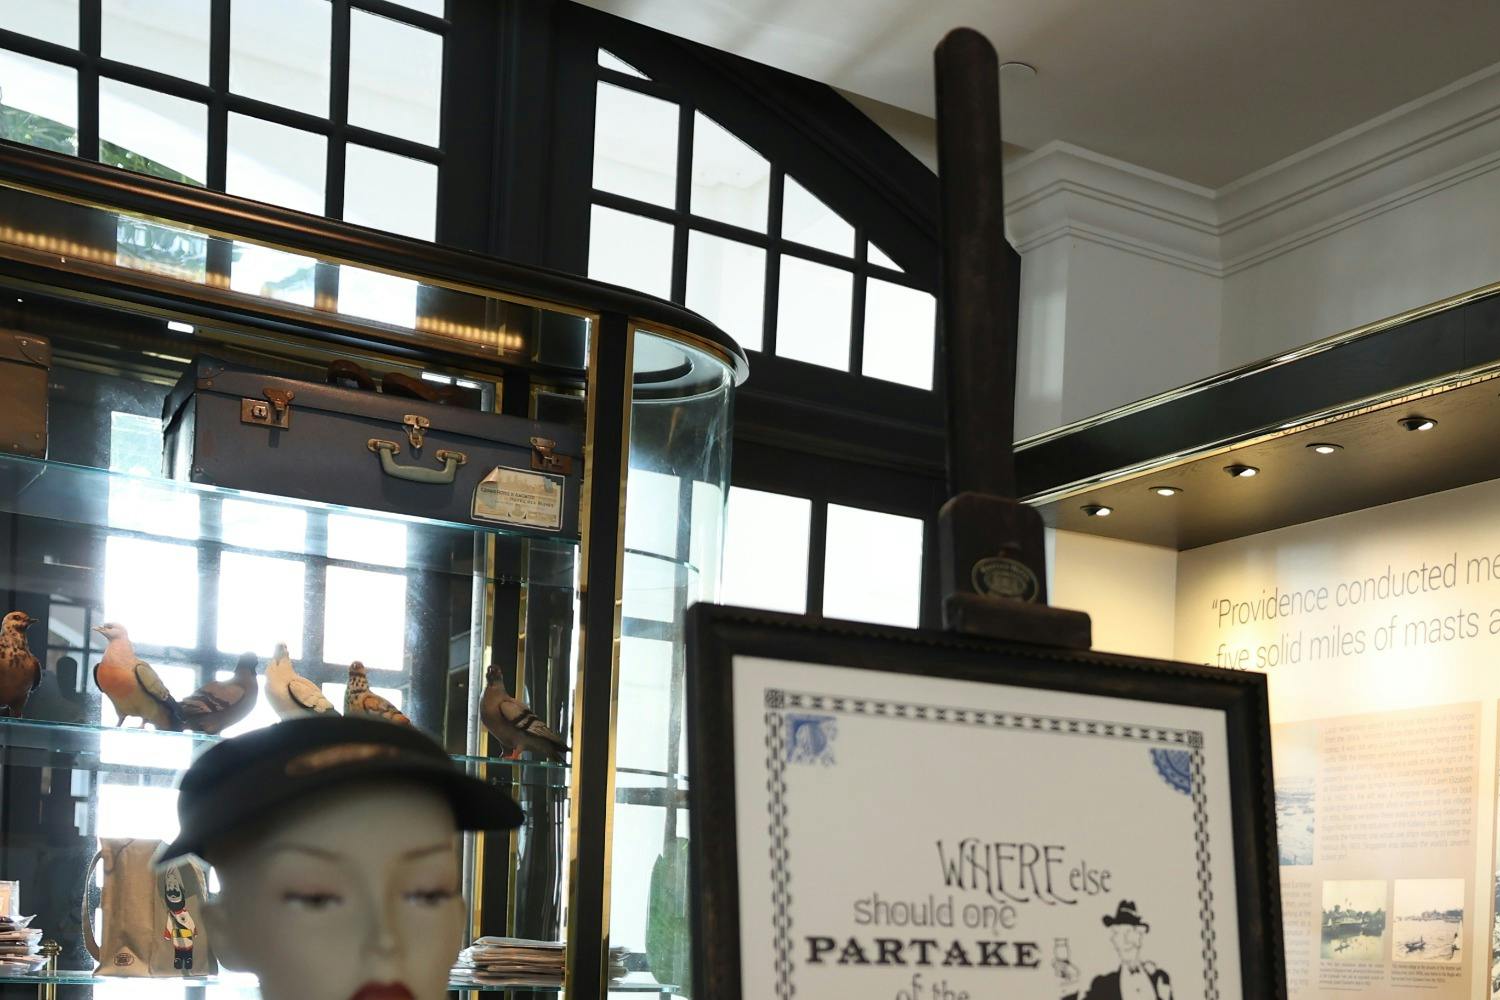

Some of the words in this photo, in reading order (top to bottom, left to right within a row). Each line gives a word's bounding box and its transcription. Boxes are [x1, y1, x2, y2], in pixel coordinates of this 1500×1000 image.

[1212, 587, 1329, 628] “Providence
[1336, 552, 1457, 608] conducted
[1216, 643, 1249, 671] five
[1256, 634, 1301, 670] solid
[1309, 625, 1366, 661] miles
[1374, 615, 1399, 651] of
[1404, 608, 1479, 647] masts
[937, 839, 1077, 906] WHERE
[1069, 863, 1112, 896] else
[854, 892, 955, 928] should
[963, 901, 1017, 937] one
[805, 936, 1041, 970] PARTAKE
